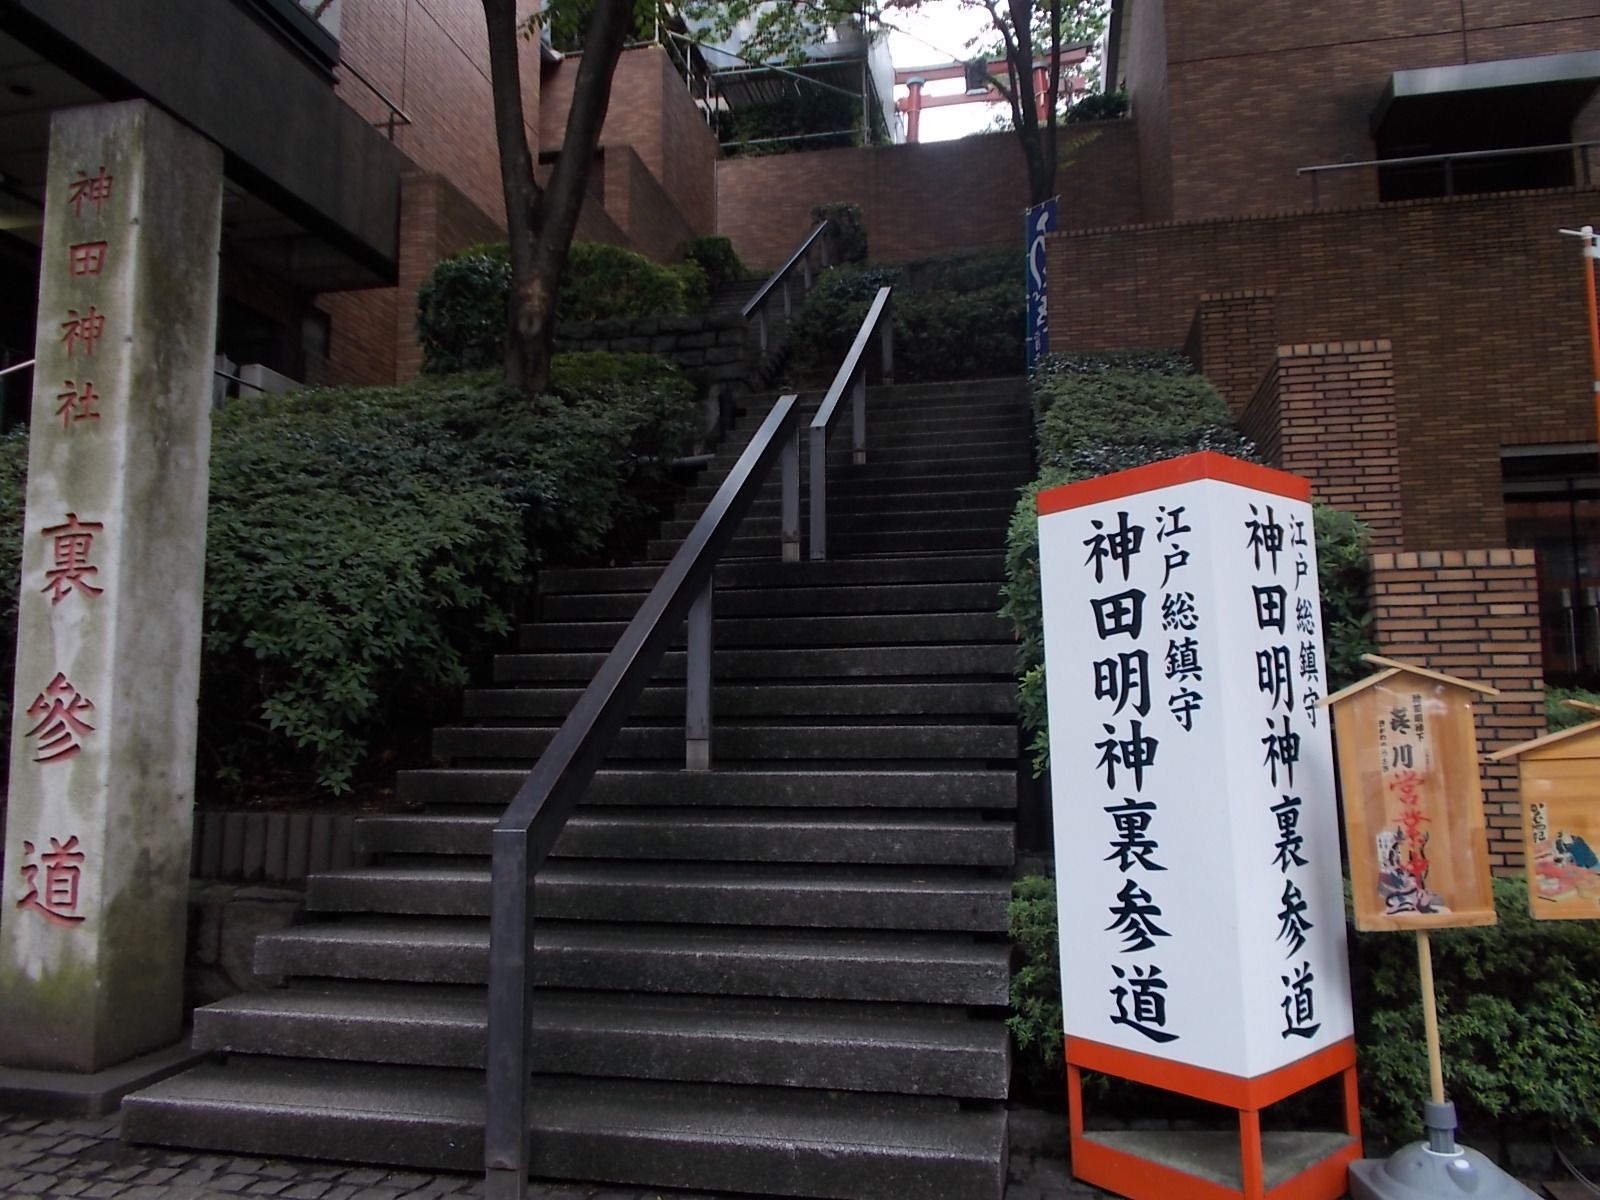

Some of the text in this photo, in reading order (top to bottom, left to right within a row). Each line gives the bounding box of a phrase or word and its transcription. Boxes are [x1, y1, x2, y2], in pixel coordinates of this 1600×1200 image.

[55, 167, 114, 429] 神田神社
[1156, 505, 1204, 732] 江戸総鎮守
[1289, 513, 1320, 729] 江戸総鎮守
[1083, 511, 1181, 1045] 神田明神裏参道
[1245, 503, 1322, 1040] 神田明神裏参道
